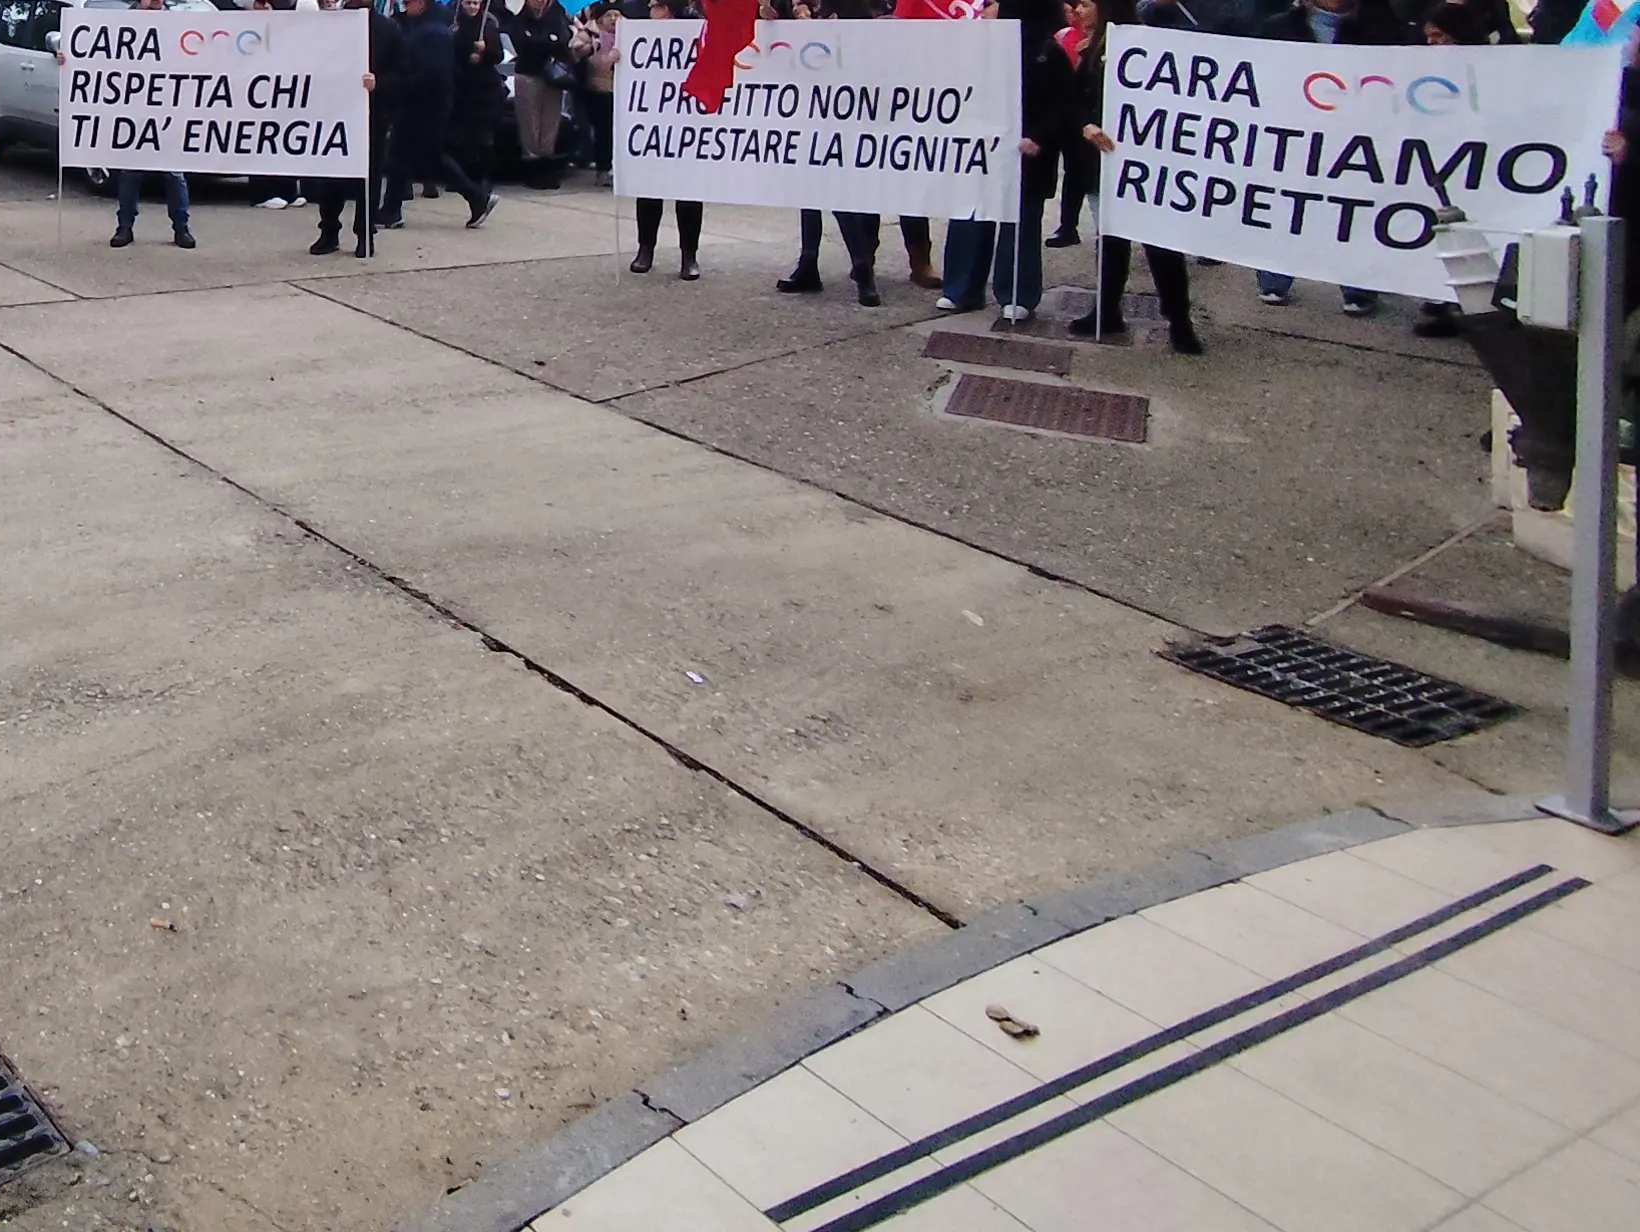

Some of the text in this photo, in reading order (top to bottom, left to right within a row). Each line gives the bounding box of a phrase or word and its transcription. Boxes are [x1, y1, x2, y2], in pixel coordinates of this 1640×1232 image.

[71, 22, 271, 61] CARA enel
[70, 70, 311, 109] RISPETTA CHI
[629, 81, 648, 112] IL
[809, 85, 880, 121] NON
[890, 86, 973, 124] PUO'
[1118, 48, 1480, 115] CARA enel
[72, 115, 348, 156] TI DA' ENERGIA
[628, 124, 1000, 175] CALPESTARE LA DIGNITA'
[1117, 103, 1567, 195] MERITIAMO
[1117, 159, 1436, 251] RISPETTO
